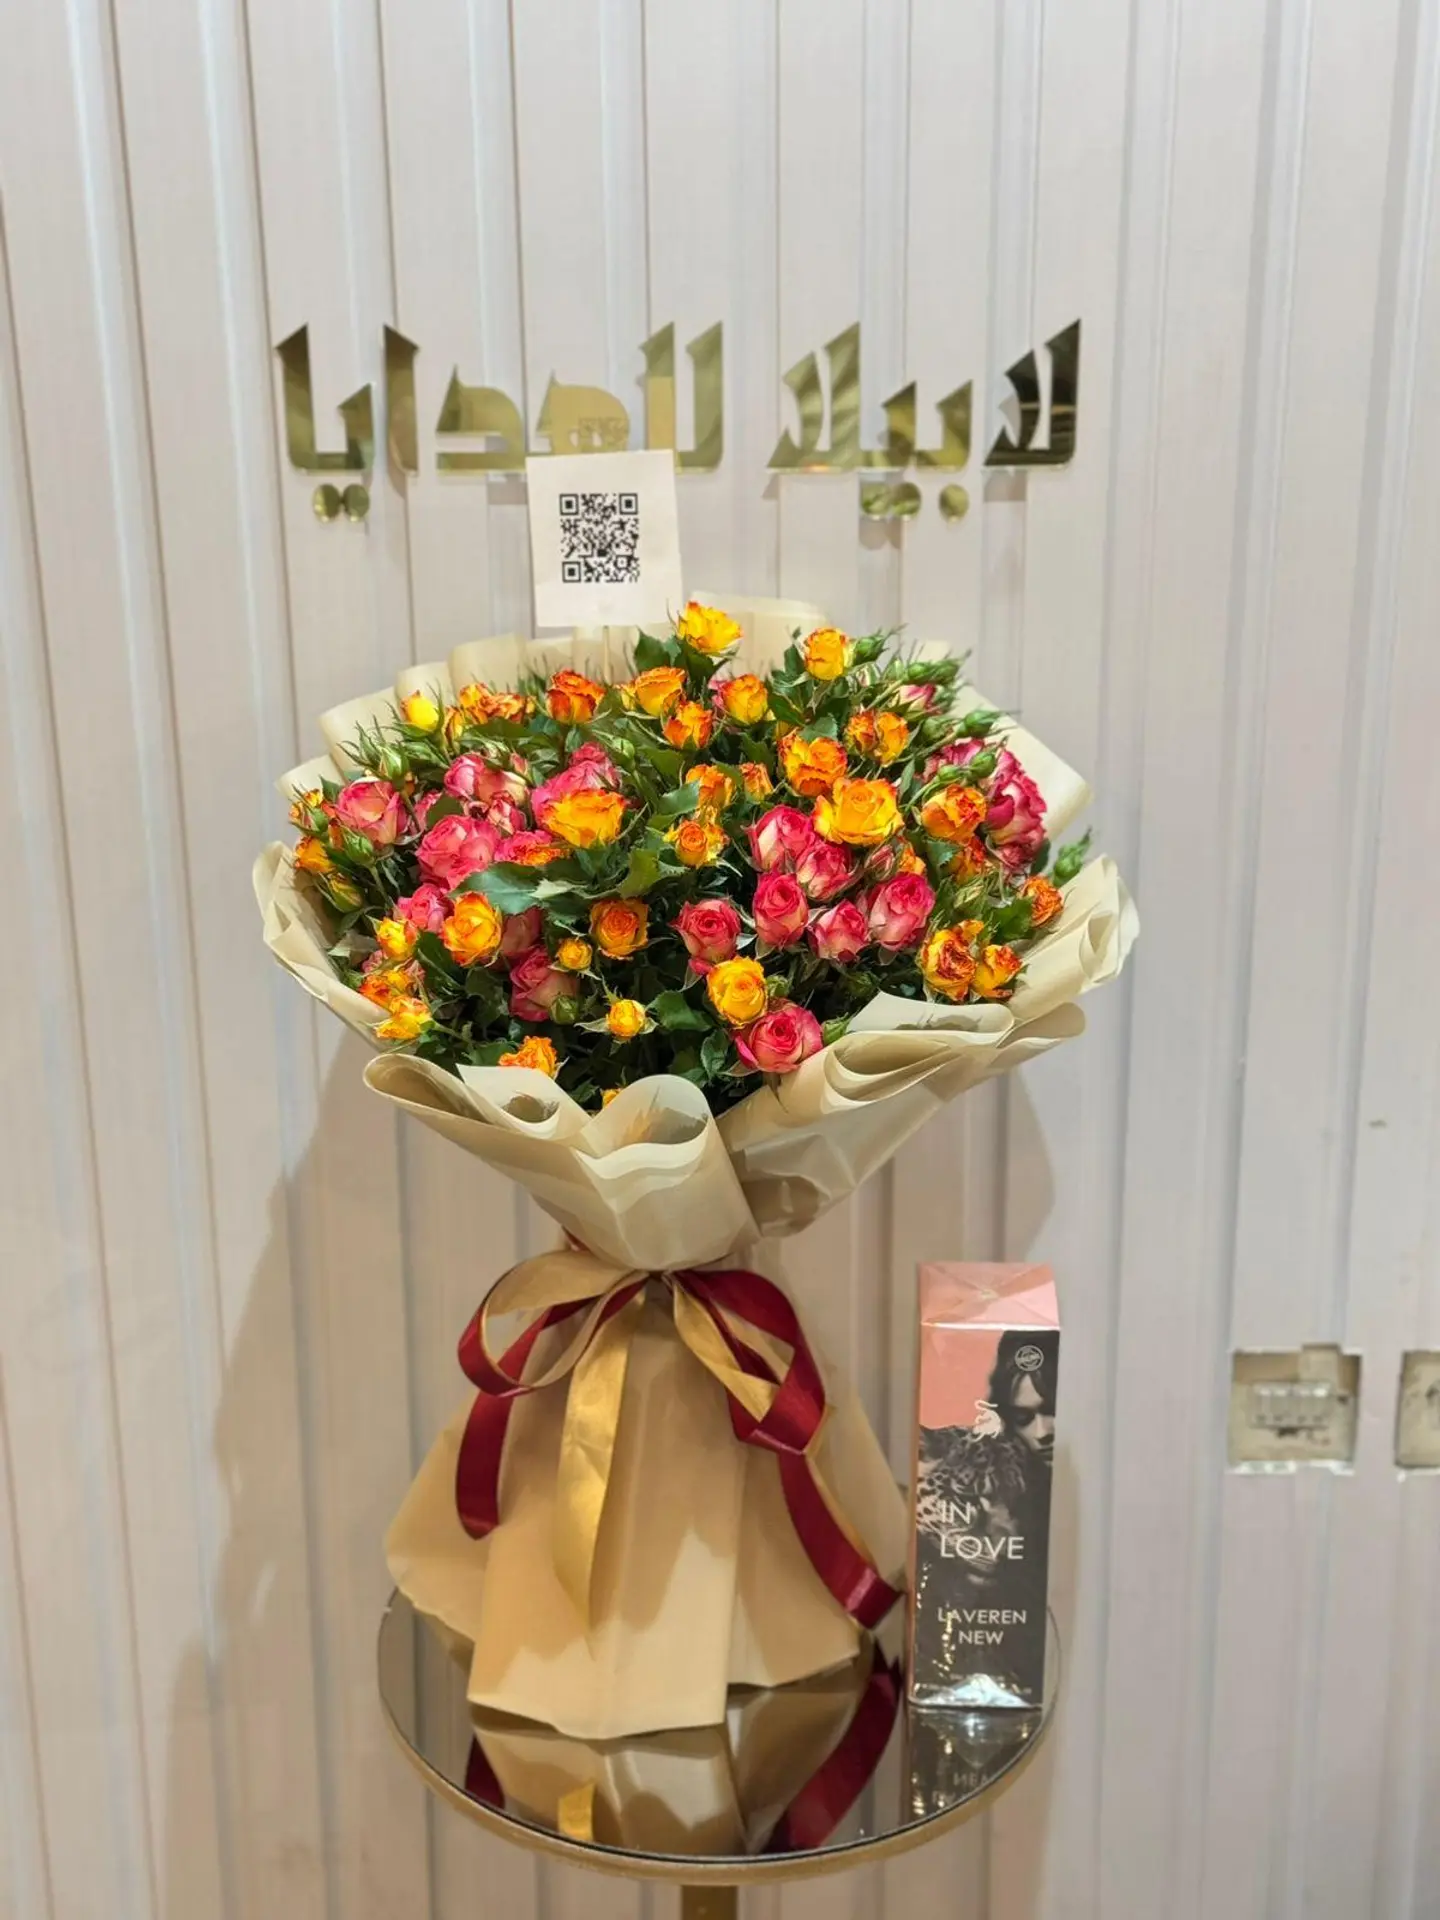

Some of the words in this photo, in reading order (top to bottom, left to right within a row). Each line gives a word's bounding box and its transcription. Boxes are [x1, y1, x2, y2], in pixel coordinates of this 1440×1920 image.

[940, 1500, 971, 1524] IN
[941, 1534, 1025, 1561] LOVE
[938, 1606, 1027, 1625] LAVEREN
[959, 1630, 1004, 1645] NEW
